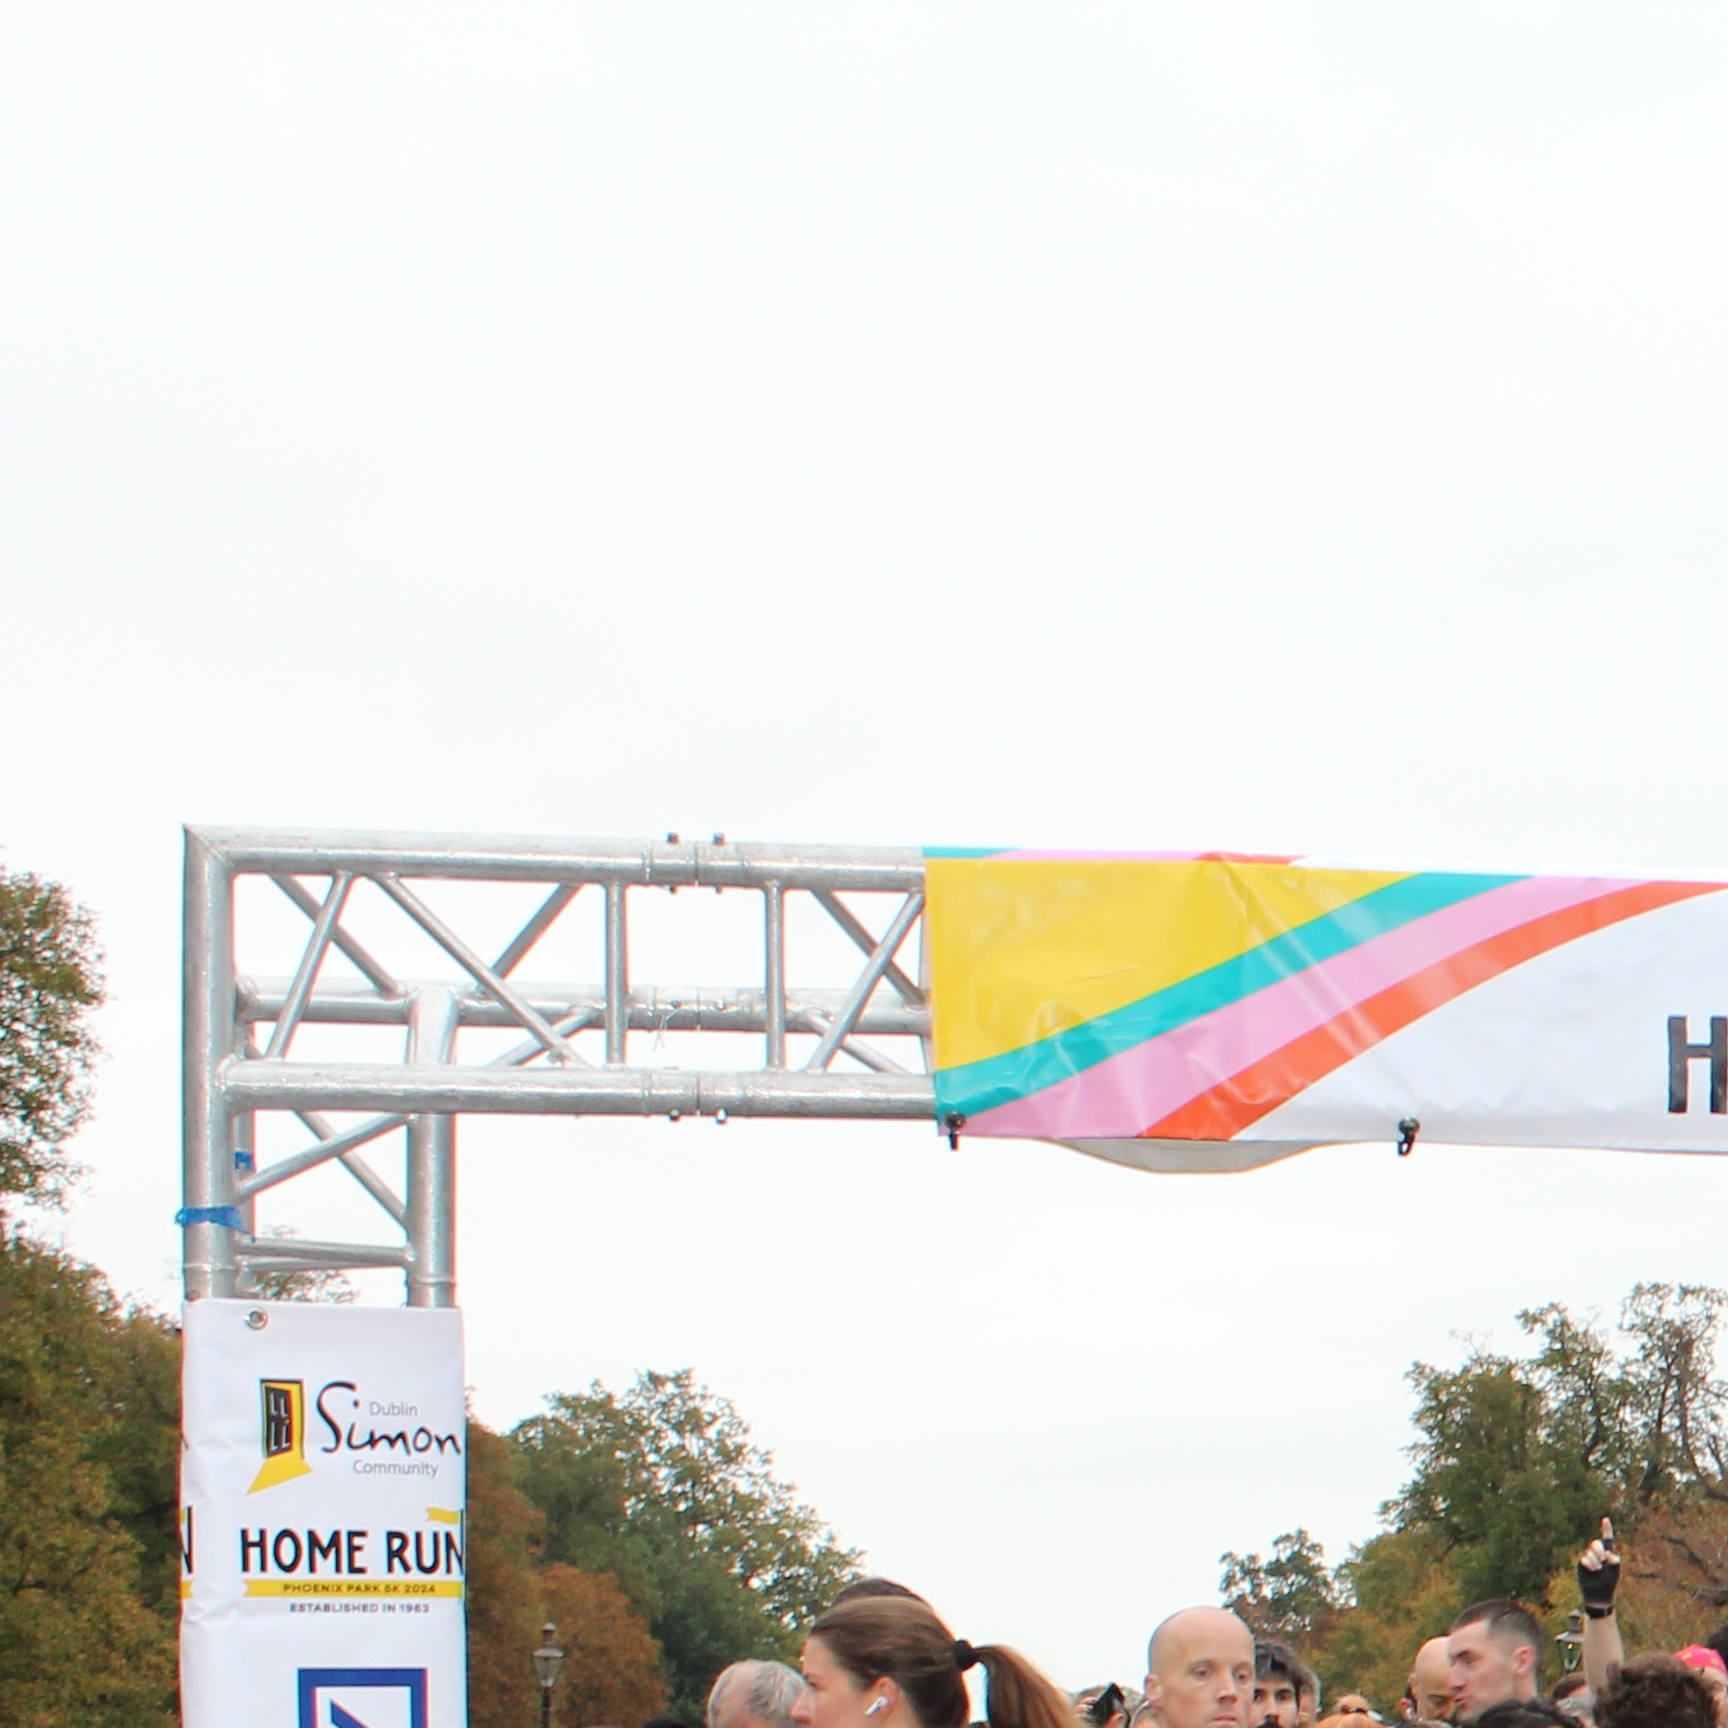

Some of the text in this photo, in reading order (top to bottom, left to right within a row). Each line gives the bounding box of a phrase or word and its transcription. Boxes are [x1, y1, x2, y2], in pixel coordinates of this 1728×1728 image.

[369, 1401, 418, 1416] Dublin
[316, 1381, 461, 1456] Simon
[352, 1459, 439, 1478] Community
[240, 1528, 369, 1574] HOME
[386, 1509, 465, 1576] RUN
[283, 1584, 436, 1593] PHOENIX PARK 5K 2024
[290, 1602, 379, 1613] ESTABLISHED
[382, 1603, 396, 1613] IN
